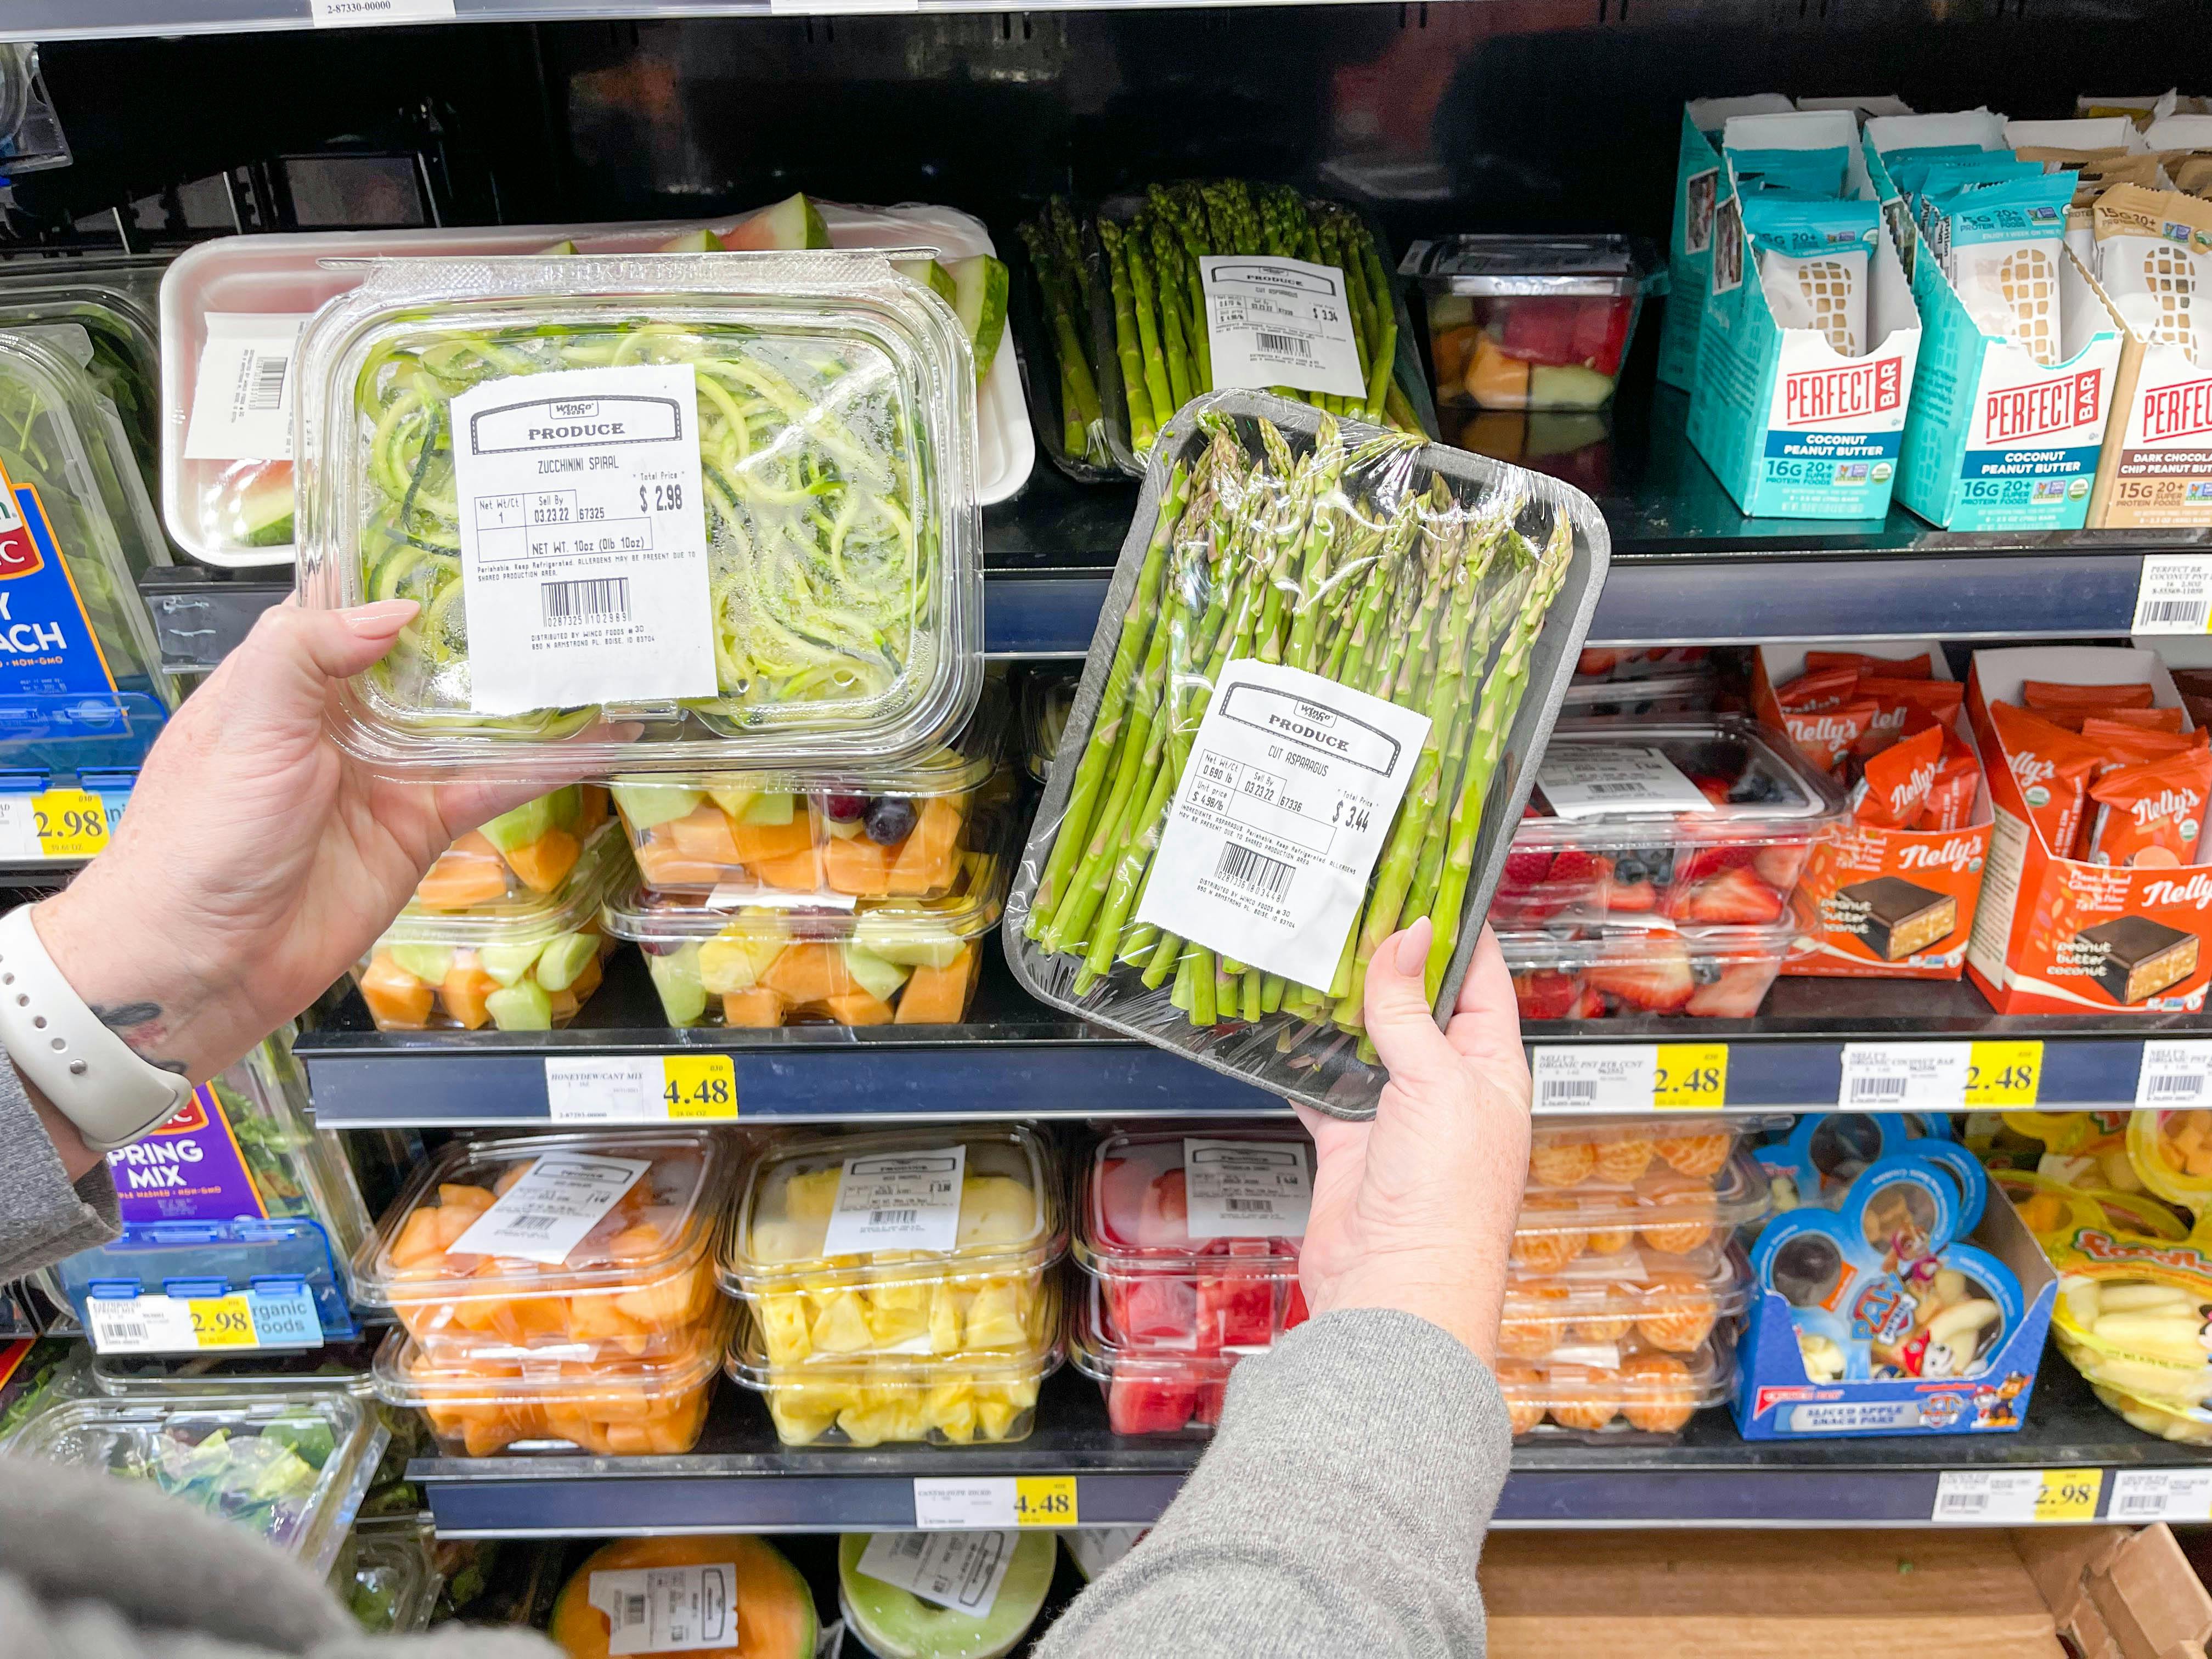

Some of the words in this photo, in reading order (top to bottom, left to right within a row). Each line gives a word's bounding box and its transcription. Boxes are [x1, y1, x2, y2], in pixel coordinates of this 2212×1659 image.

[328, 1, 391, 14] 2-87330-00000
[1246, 274, 1304, 287] PRODUCE
[1321, 309, 1339, 323] 3.34
[1787, 369, 1874, 420] PERFECT
[1879, 361, 1897, 408] BAR
[556, 402, 593, 413] WinCo
[1986, 381, 2073, 439] PERFECT
[2078, 374, 2096, 422] BAR
[528, 422, 625, 441] PRODUCE
[1806, 435, 1867, 445] COCONUT
[1784, 445, 1835, 456] PEANUT
[1836, 446, 1884, 456] BUTTER
[2005, 451, 2066, 462] COCONUT
[2133, 453, 2163, 463] DARK
[538, 460, 584, 475] ZUCCHININI
[589, 455, 619, 470] SPIRAL
[1767, 460, 1802, 477] 16G
[1805, 461, 1834, 472] 20+
[1981, 464, 2033, 475] PEANUT
[2034, 461, 2081, 474] BUTTER
[2120, 464, 2147, 475] CHIP
[2147, 464, 2191, 474] PEANUT
[641, 473, 657, 481] Total
[661, 471, 678, 479] Price
[1963, 481, 1999, 497] 16G
[2003, 480, 2032, 491] 20+
[2119, 482, 2153, 499] 15G
[2157, 482, 2185, 493] 20+
[479, 500, 493, 510] Net
[496, 499, 520, 509] Wt/Ct
[539, 496, 551, 506] Sell
[555, 495, 564, 506] By
[639, 484, 648, 514] $
[655, 484, 683, 512] 2.98
[499, 512, 504, 524] 1
[534, 507, 569, 523] 03.23.22
[579, 506, 605, 520] 67325
[532, 542, 548, 555] NET
[553, 540, 569, 554] WT.
[574, 539, 594, 553] 10oz
[620, 537, 645, 550] 10oz)
[578, 557, 612, 566] ALLERGENS
[614, 555, 629, 563] MAY
[642, 553, 670, 562] PRESENT
[478, 574, 500, 582] SHARED
[503, 571, 539, 580] PRODUCTION
[548, 615, 583, 628] 0287325
[589, 613, 627, 625] 102989
[531, 633, 569, 642] DISTRIBUTED
[582, 629, 602, 638] WINCO
[605, 628, 625, 636] FOODS
[554, 640, 590, 648] ARMSTRONG
[12, 656, 63, 667] NON-GMO
[1300, 704, 1331, 721] WinCo
[1268, 714, 1350, 752] PRODUCE
[1786, 717, 1859, 752] Nelly's
[1205, 751, 1216, 762] Net
[1219, 755, 1239, 772] Wt/Ct
[1268, 744, 1283, 759] CUT
[1285, 751, 1329, 777] ASPARAGUS
[1203, 766, 1223, 780] 0.690
[1225, 773, 1232, 784] lb
[1254, 772, 1264, 782] Sell
[1266, 777, 1274, 787] By
[1197, 780, 1210, 793] Unit
[1212, 786, 1228, 800] price
[1244, 780, 1274, 802] 03.23.22
[1279, 795, 1303, 812] 67336
[1343, 790, 1358, 803] Total
[1192, 791, 1200, 803] $
[1200, 795, 1224, 811] 4.98/lb
[2131, 787, 2200, 826] Nelly's
[33, 810, 103, 838] 2.98
[1332, 799, 1344, 823] $
[1345, 805, 1371, 834] 3.44
[1178, 811, 1190, 820] MAY
[1191, 815, 1199, 823] BE
[1199, 819, 1223, 832] PRESENT
[1223, 827, 1235, 837] DUE
[1236, 832, 1243, 840] TO
[1245, 836, 1263, 849] SHARED
[1264, 843, 1295, 860] PRODUCTION
[1898, 834, 1982, 873] Nelly's
[1329, 861, 1357, 876] ALLERGENS
[1217, 870, 1246, 889] 0287336
[1249, 884, 1282, 903] 803448
[1199, 878, 1230, 895] DISTRIBUTED
[1231, 890, 1238, 899] BY
[1239, 893, 1256, 906] WINCO
[1258, 901, 1274, 913] FOODS
[1282, 909, 1291, 918] 30
[1214, 892, 1243, 909] ARMSTRONG
[1821, 899, 1872, 912] peanut
[2056, 941, 2113, 953] peanut
[2056, 953, 2107, 965] butter
[2046, 966, 2108, 977] coconut
[1539, 1054, 1575, 1063] NELLY'S
[1620, 1060, 1644, 1069] CCNT
[551, 1072, 624, 1081] HONEYDEW/CANT
[1651, 1067, 1720, 1093] 2.48
[1962, 1065, 2032, 1091] 2.48
[663, 1078, 729, 1104] 4.48
[106, 1139, 204, 1167] PRING
[127, 1165, 188, 1189] MIX
[251, 1301, 308, 1318] rganic
[1851, 1271, 1905, 1340] PAW
[190, 1311, 248, 1334] 2.98
[2033, 1483, 2092, 1505] 2.98
[1013, 1493, 1069, 1514] 4.48
